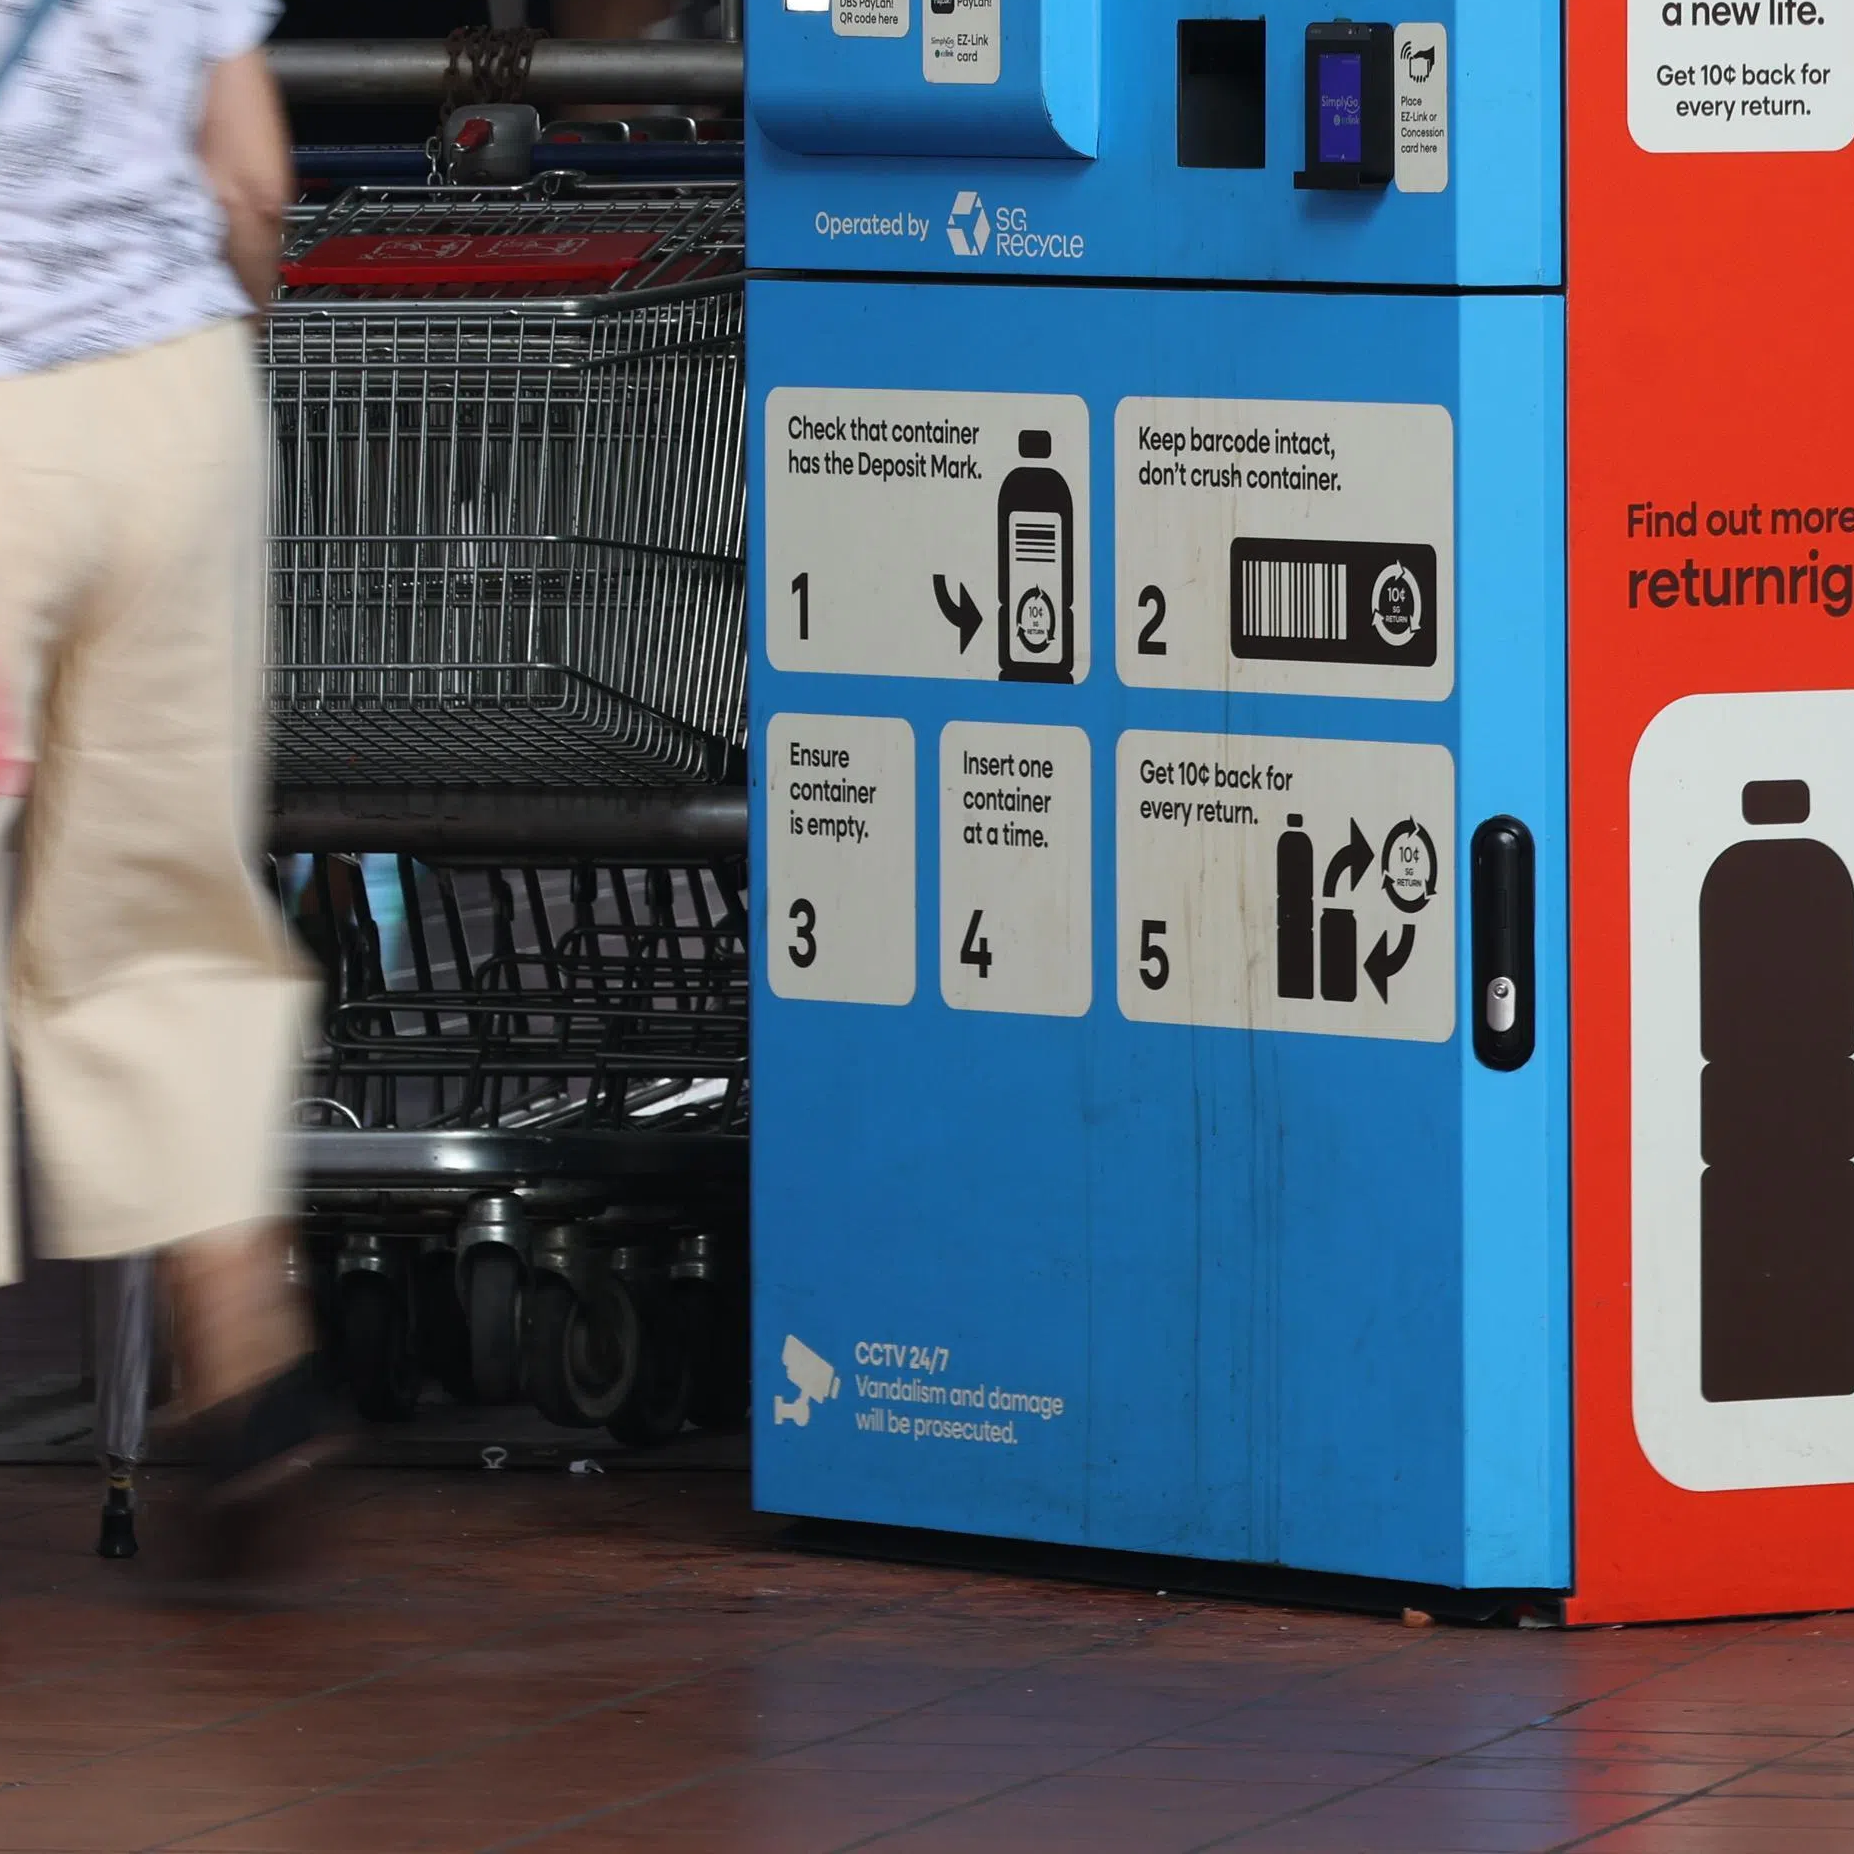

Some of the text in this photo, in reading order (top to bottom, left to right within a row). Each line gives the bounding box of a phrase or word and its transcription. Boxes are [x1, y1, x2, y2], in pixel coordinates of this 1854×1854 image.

[840, 12, 898, 24] QR code here
[1662, 2, 1681, 26] a
[1692, 2, 1760, 26] new
[1657, 63, 1830, 86] Get 10¢ back for
[1677, 96, 1810, 121] every return.
[816, 212, 929, 241] Operated by
[997, 208, 1026, 231] SG
[789, 417, 979, 444] Check that container
[1139, 427, 1335, 459] Keep barcode intact,
[789, 450, 982, 481] has the Deposit Mark.
[1191, 463, 1241, 488] crush
[1246, 466, 1341, 491] container.
[1628, 501, 1696, 538] Find
[1706, 503, 1762, 536] out
[792, 572, 808, 640] 1
[1138, 585, 1166, 655] 2
[791, 742, 849, 768] Ensure
[964, 751, 1053, 778] Insert one
[790, 778, 876, 803] container
[963, 787, 1051, 813] container
[791, 810, 868, 843] is empty.
[964, 822, 1048, 847] at a time.
[789, 898, 816, 968] 3
[961, 910, 992, 978] 4
[1140, 920, 1169, 990] 5
[855, 1342, 948, 1374] CCTV 24/7
[855, 1374, 1063, 1420] Vandalism and damage
[855, 1408, 1017, 1444] will be prosecuted.
